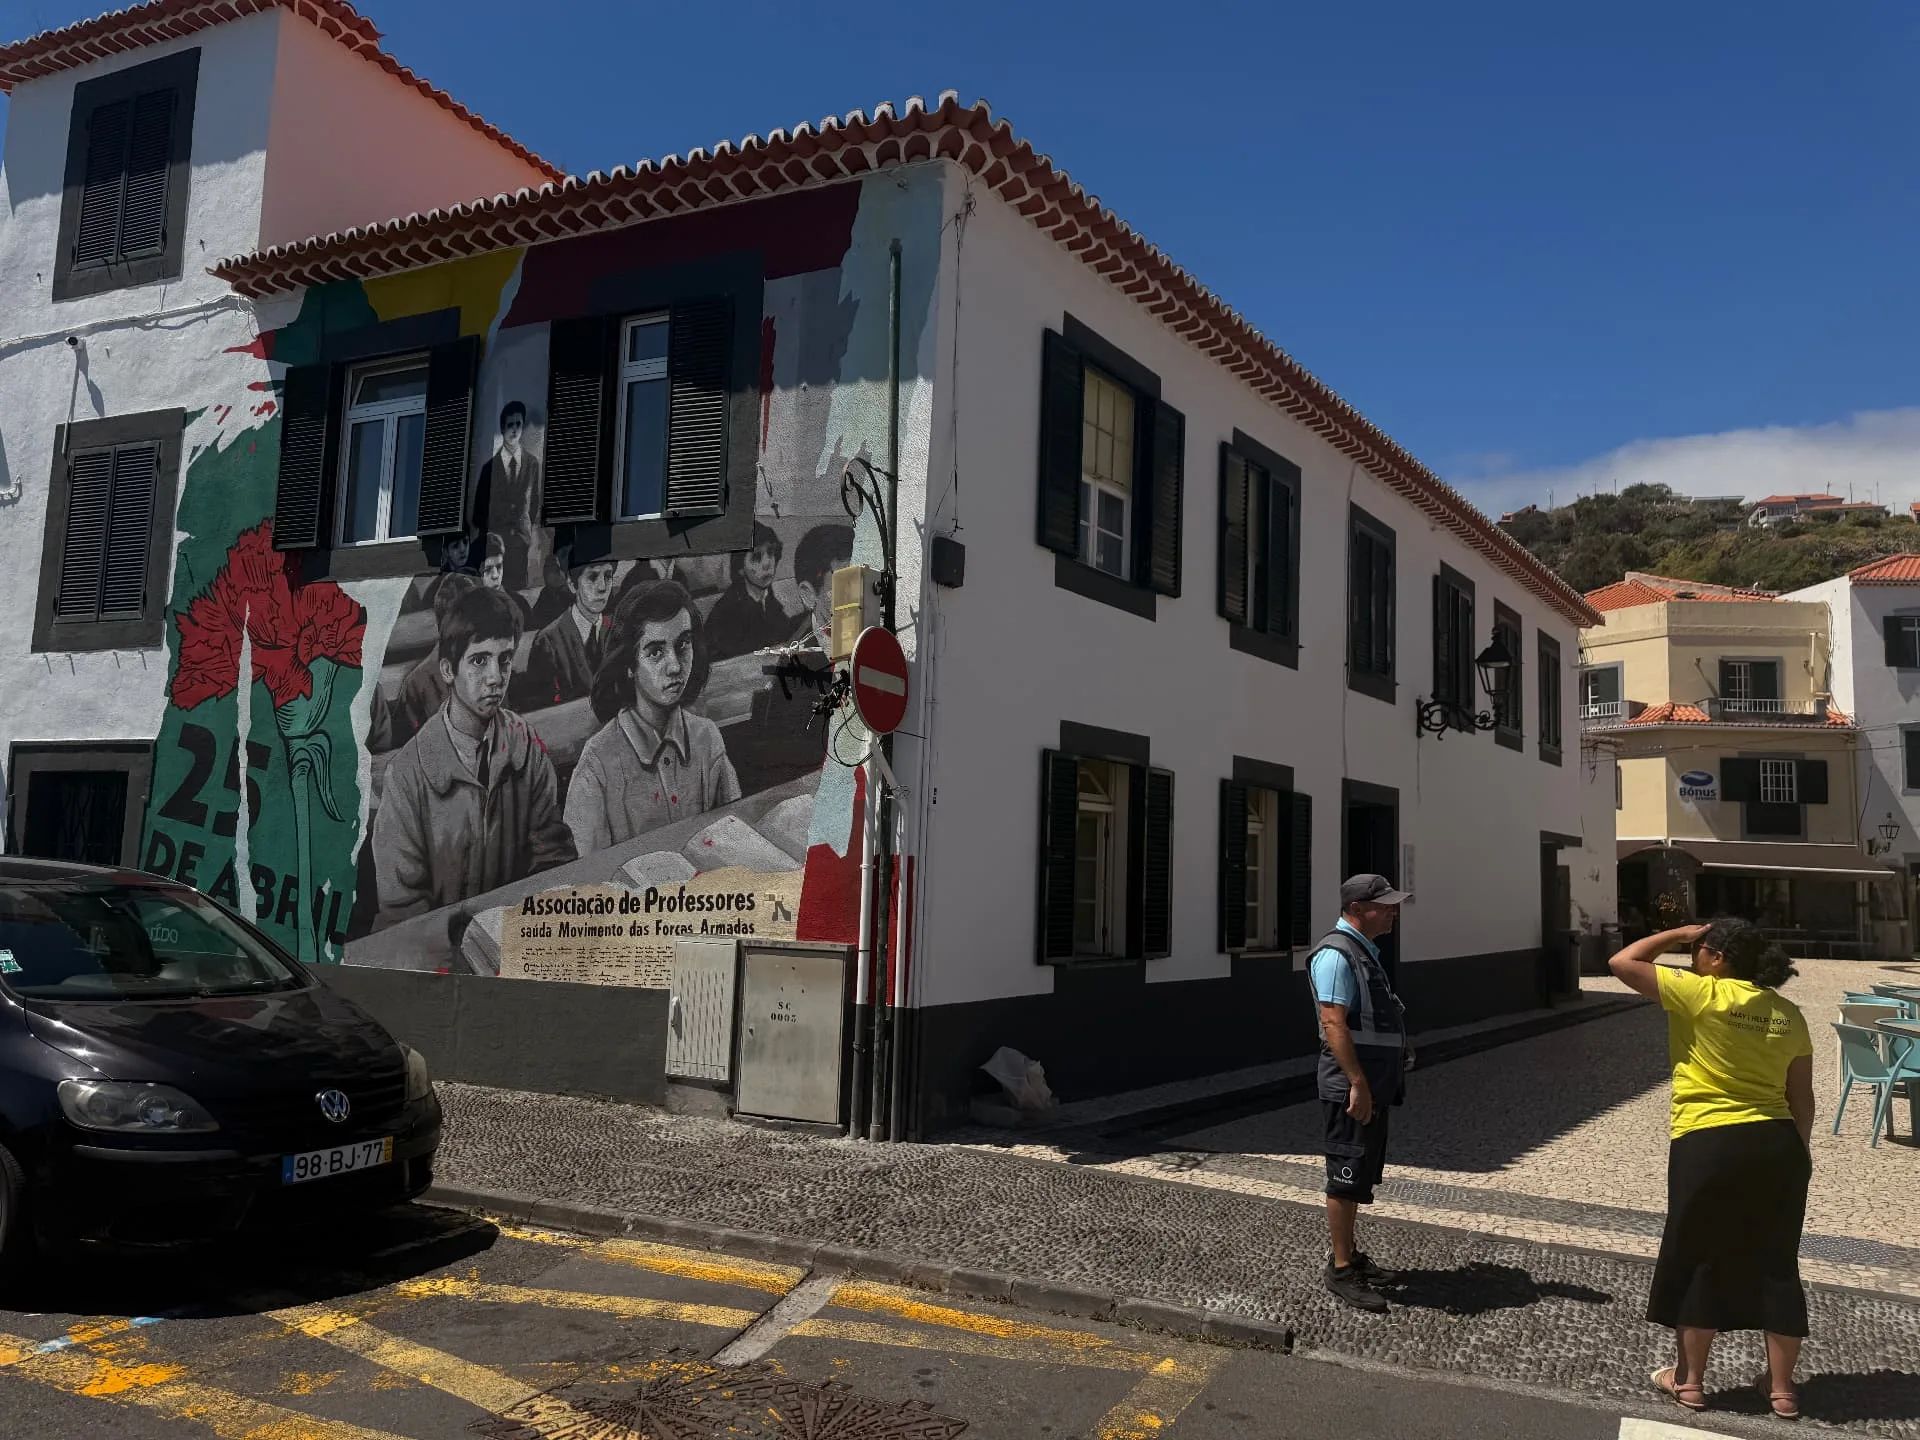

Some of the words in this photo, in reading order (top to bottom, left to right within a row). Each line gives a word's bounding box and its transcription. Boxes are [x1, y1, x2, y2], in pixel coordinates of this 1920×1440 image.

[158, 722, 272, 838] 25
[143, 830, 205, 888] DE
[207, 856, 347, 946] ABRIL
[521, 890, 615, 918] Associação
[619, 890, 640, 914] de
[644, 885, 755, 913] Professores
[520, 921, 552, 938] saúda
[558, 921, 624, 938] Movimento
[629, 919, 650, 937] das
[700, 917, 755, 936] Armadas
